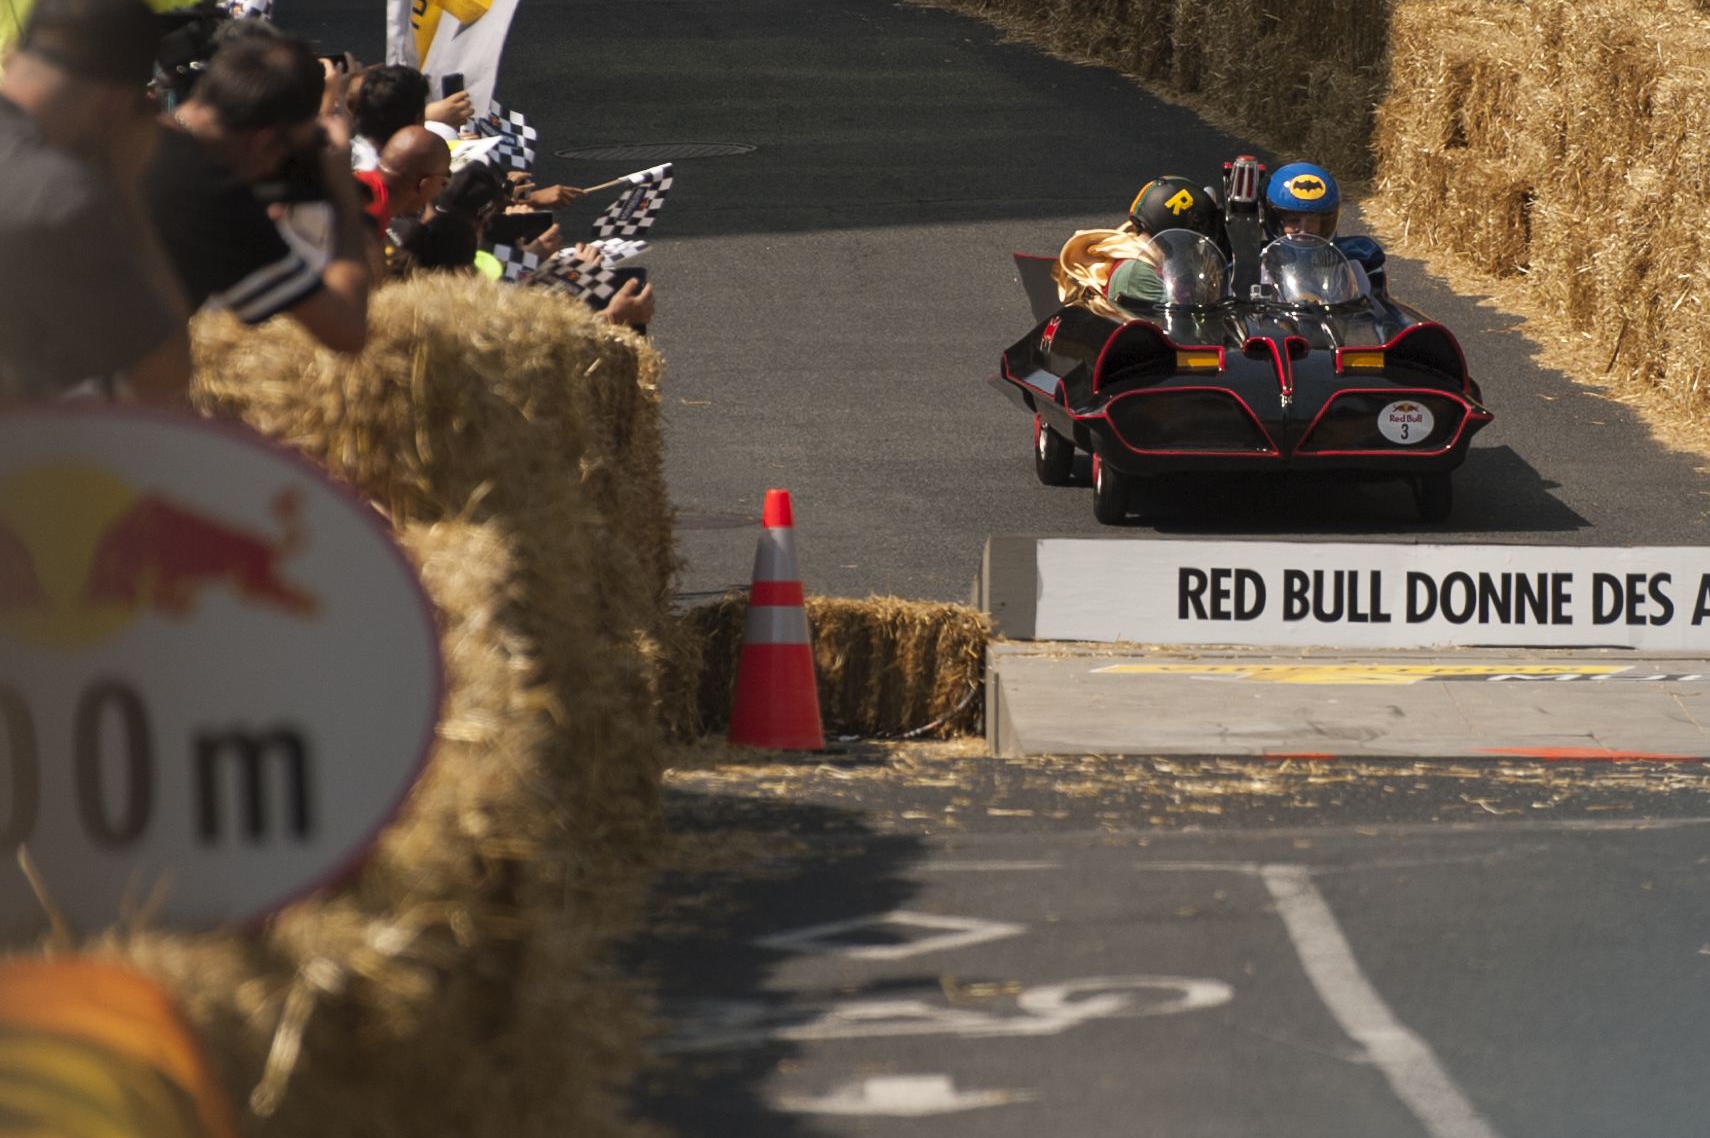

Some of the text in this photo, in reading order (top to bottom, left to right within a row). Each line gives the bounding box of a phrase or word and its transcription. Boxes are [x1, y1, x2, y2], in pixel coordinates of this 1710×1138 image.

[1164, 189, 1194, 216] R
[1389, 414, 1423, 423] Red Bull
[1400, 423, 1409, 440] 3
[1178, 568, 1266, 621] RED
[1282, 569, 1392, 624] BULL
[1406, 571, 1573, 625] DONNE
[1592, 572, 1674, 627] DES
